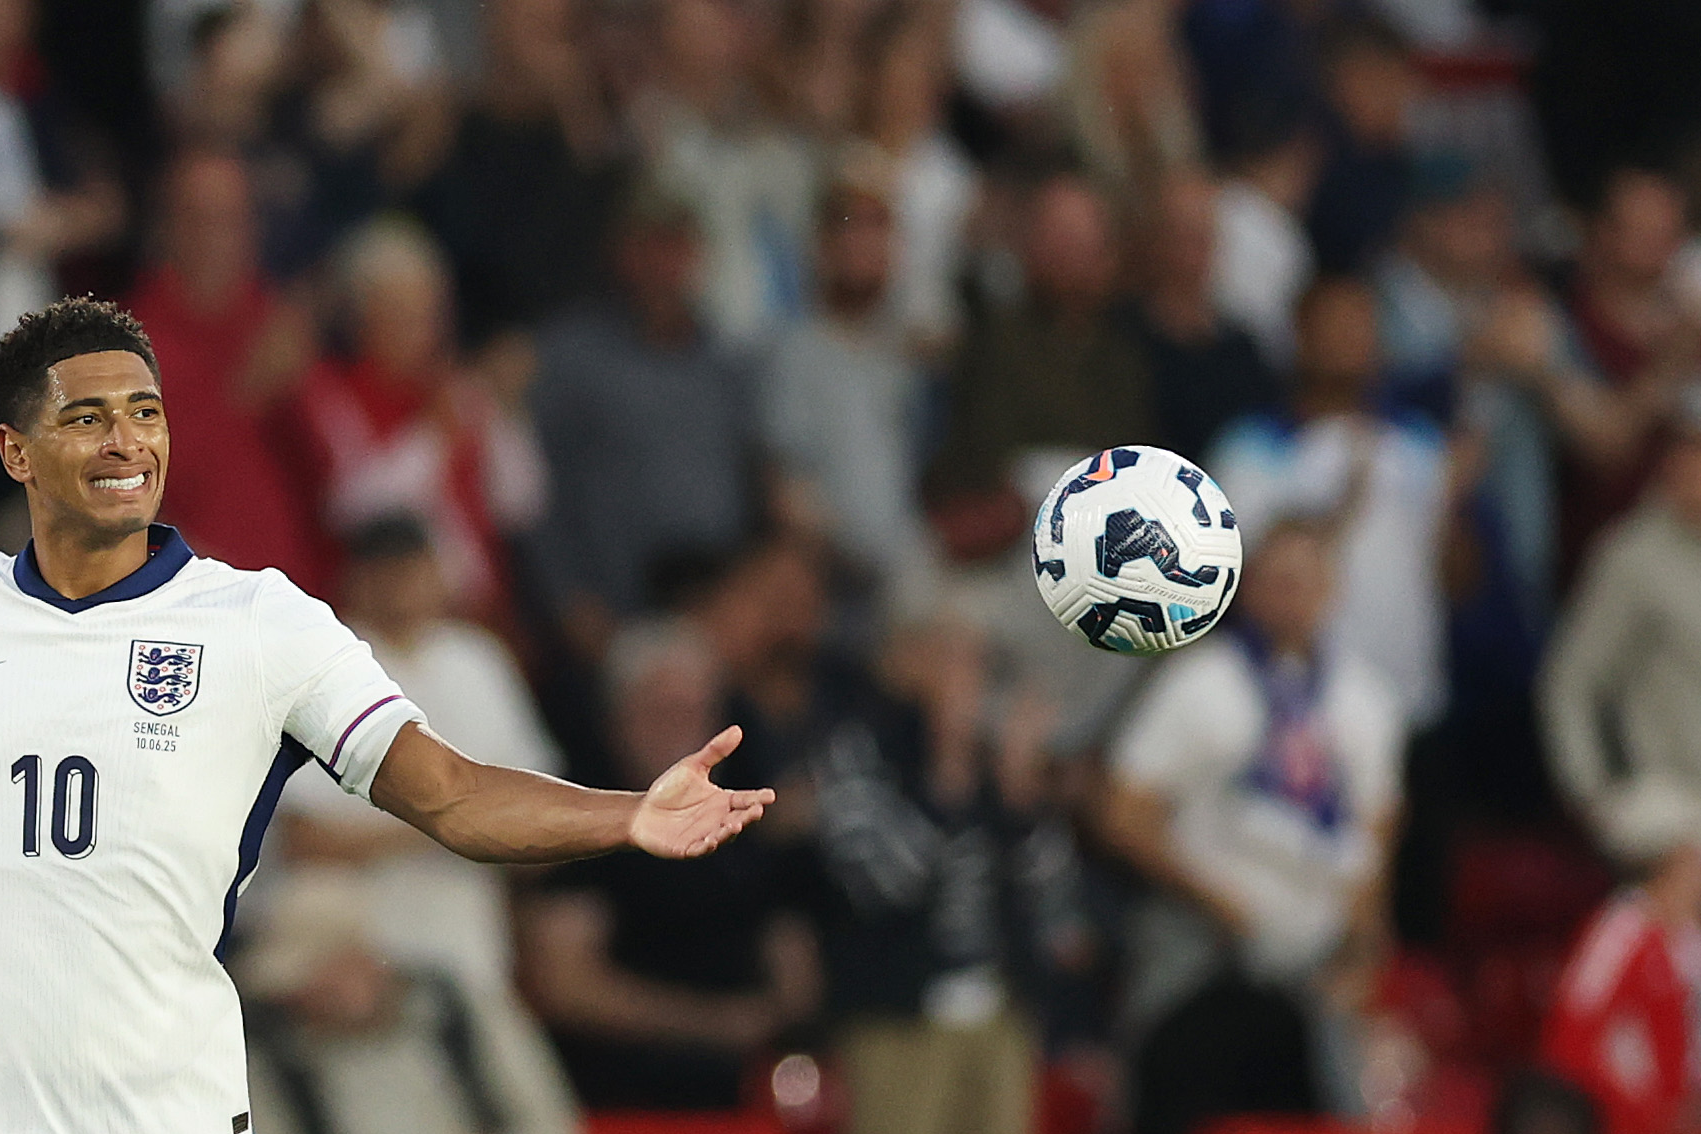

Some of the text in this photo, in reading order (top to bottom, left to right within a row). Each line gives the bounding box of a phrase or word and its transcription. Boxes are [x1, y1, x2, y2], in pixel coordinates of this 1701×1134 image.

[133, 722, 180, 737] SENEGAL
[136, 738, 176, 752] 10.06.25
[11, 754, 99, 860] 10
